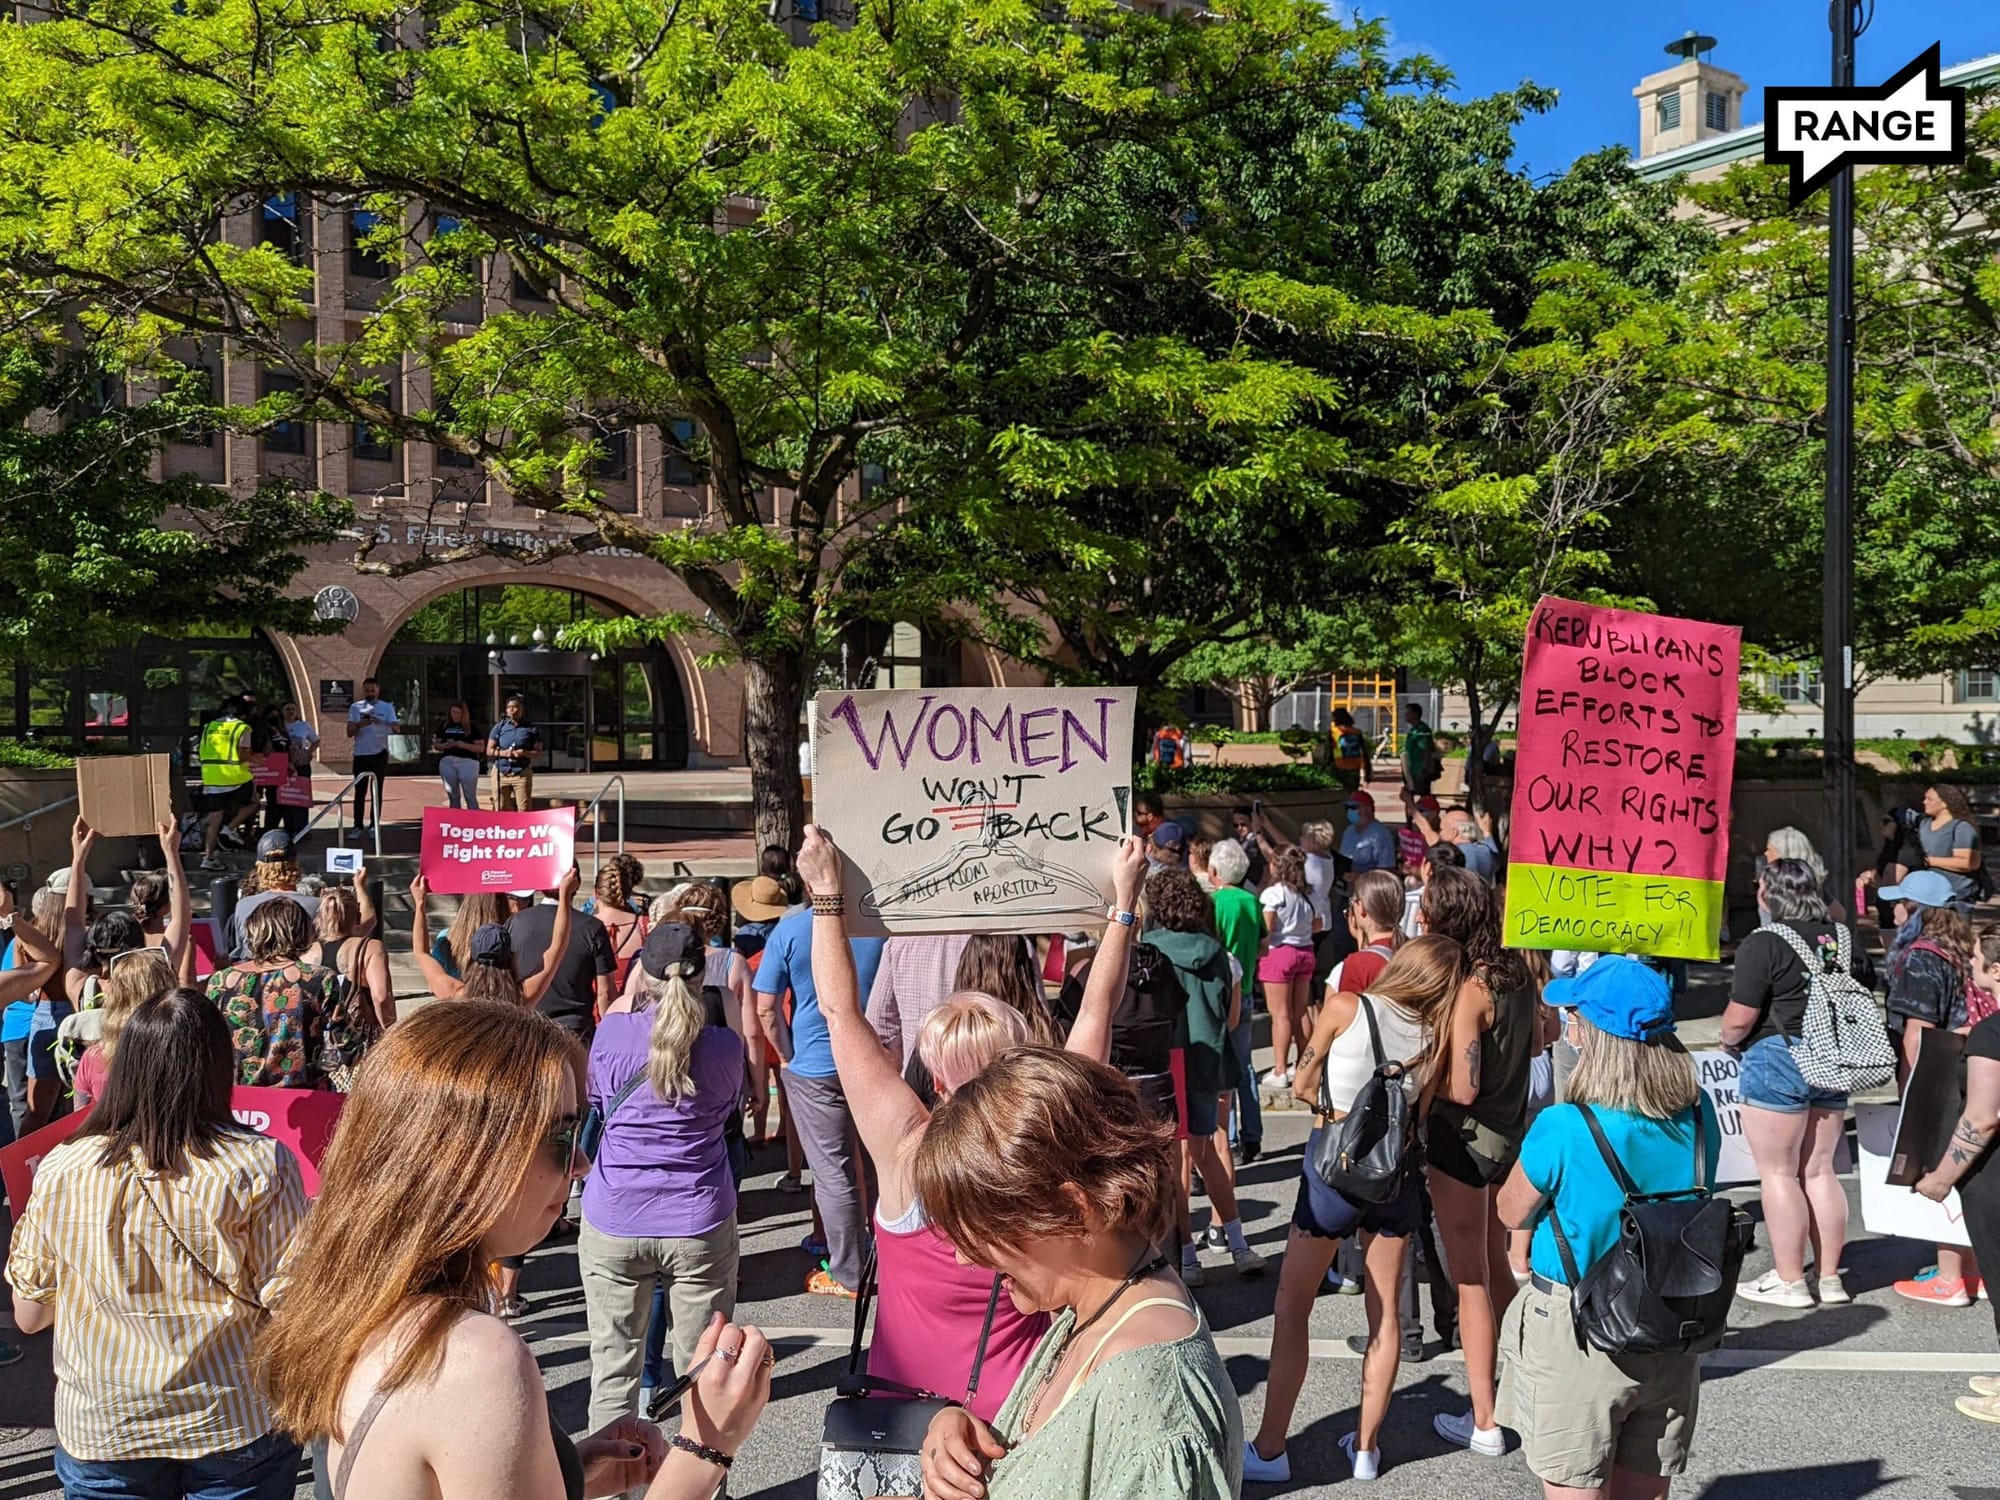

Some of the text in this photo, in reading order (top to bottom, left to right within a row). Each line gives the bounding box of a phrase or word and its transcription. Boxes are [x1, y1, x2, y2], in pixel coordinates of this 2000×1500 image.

[1534, 607, 1724, 678] REPUBLICANS
[1576, 656, 1686, 698] BLOCK
[1534, 687, 1681, 734] EFFORTS
[829, 693, 1120, 774] WOMEN
[1561, 729, 1707, 786] RESTORE
[922, 774, 1046, 809] WON'T
[1528, 774, 1720, 835] OUR RIGHTS
[439, 822, 526, 843] Together
[881, 785, 1131, 848] GO BACK!
[442, 842, 554, 863] Fight for All
[1528, 868, 1698, 918] VOTE FOR
[1514, 910, 1664, 946] DEMOCRACY
[1701, 1059, 1738, 1085] ABO
[1714, 1088, 1739, 1108] RIG
